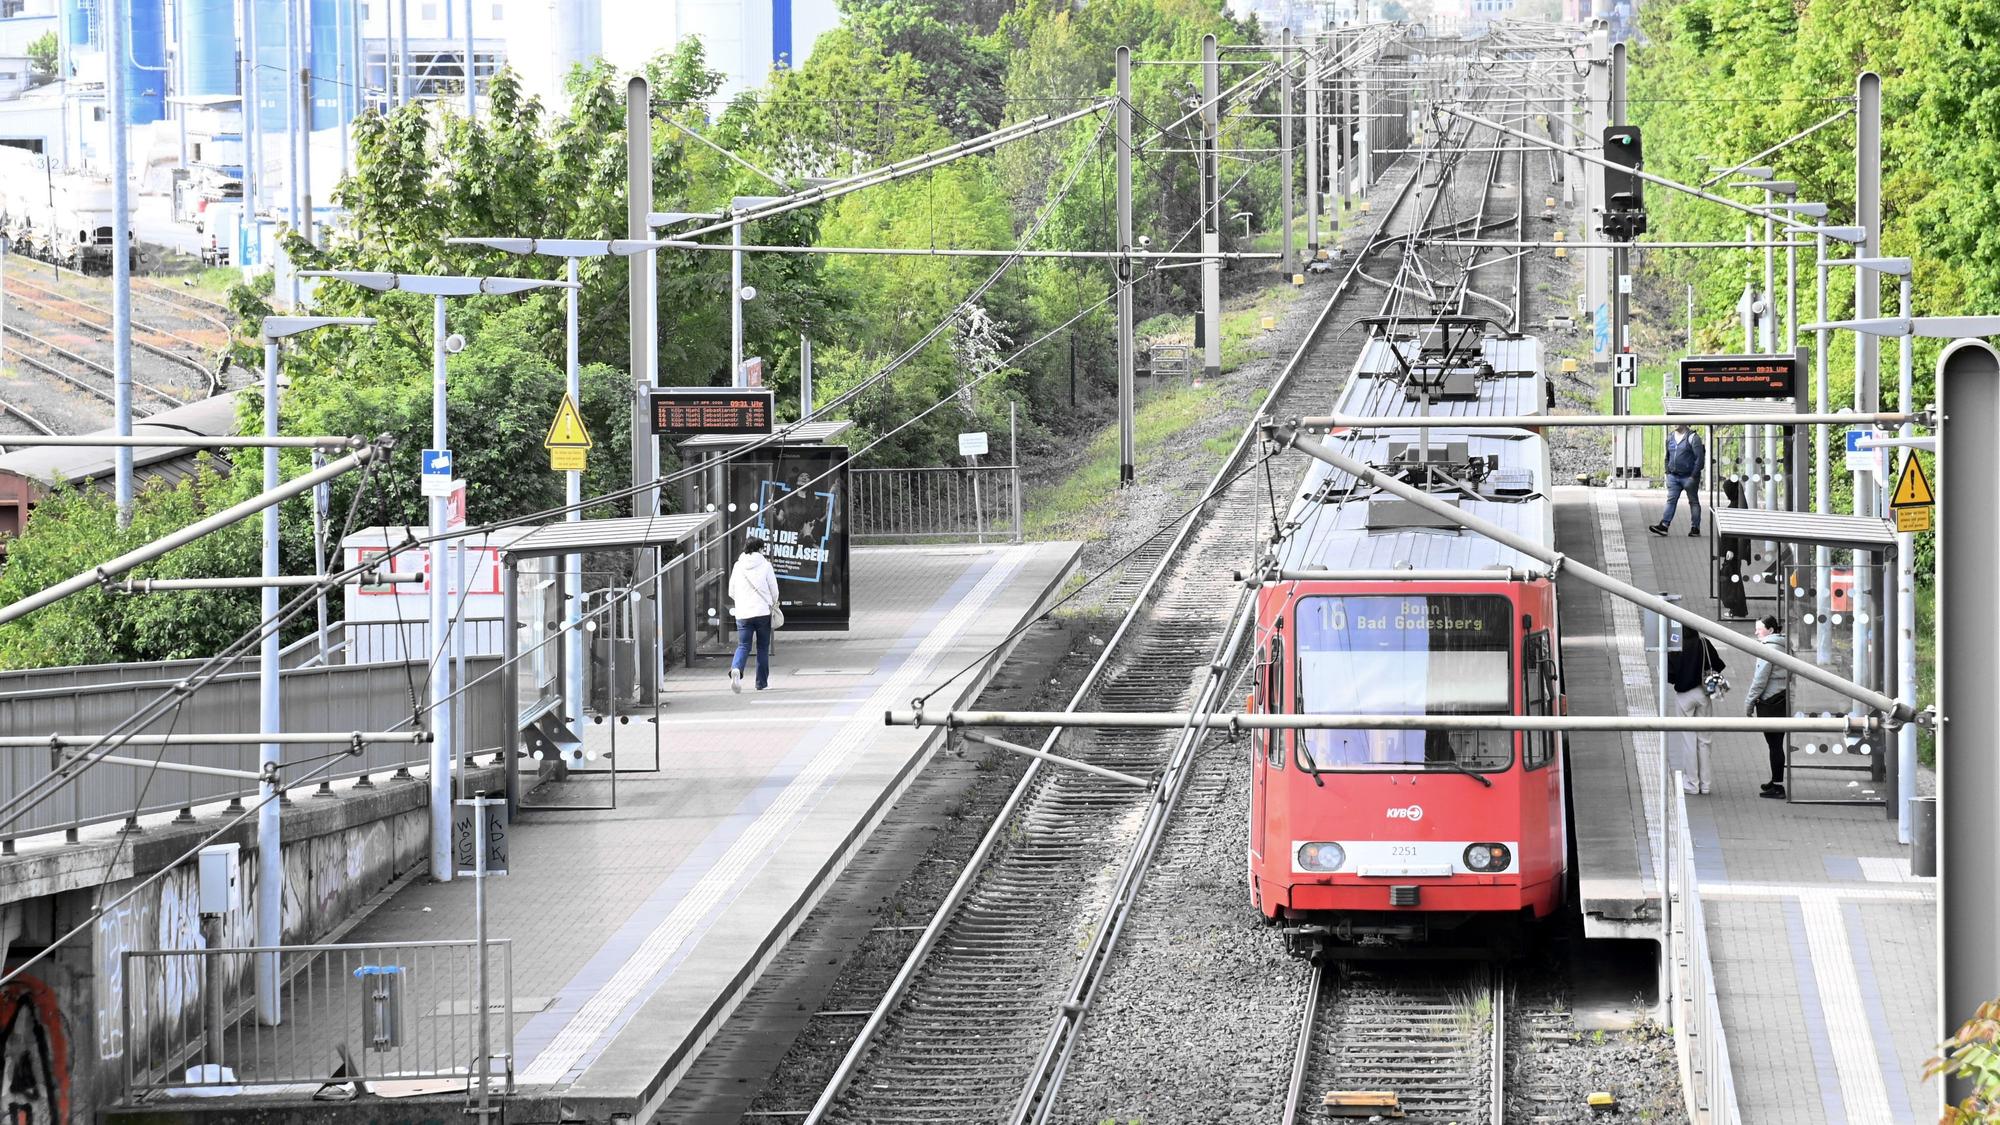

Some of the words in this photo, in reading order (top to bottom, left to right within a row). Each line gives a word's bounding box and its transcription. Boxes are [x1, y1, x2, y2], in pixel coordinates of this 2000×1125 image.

[1736, 375, 1770, 383] Godesberg
[779, 530, 798, 544] DIE
[1319, 601, 1345, 631] 16
[1400, 602, 1440, 615] Bonn
[1357, 616, 1386, 629] Bad
[1394, 616, 1483, 631] Godesberg
[1386, 807, 1407, 818] KVB
[1392, 846, 1417, 856] 2251
